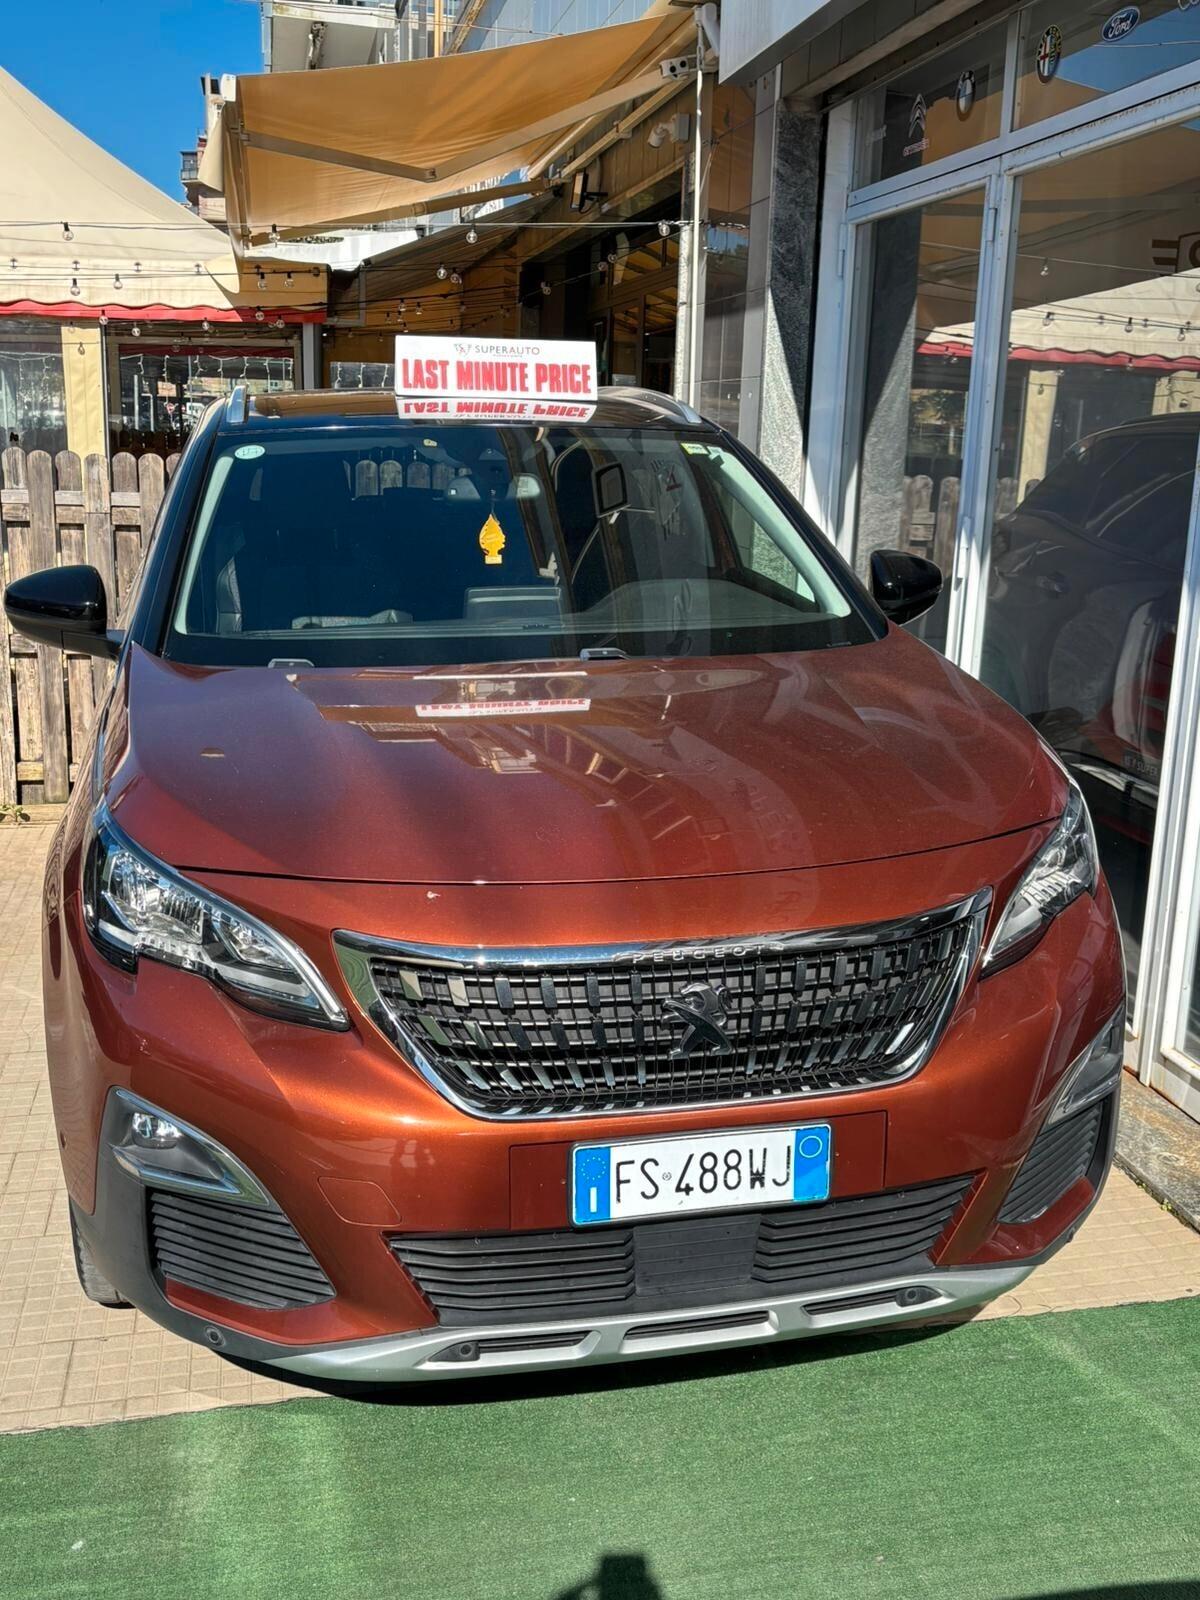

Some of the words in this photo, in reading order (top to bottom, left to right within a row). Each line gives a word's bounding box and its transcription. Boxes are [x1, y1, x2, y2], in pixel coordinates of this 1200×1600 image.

[1107, 13, 1134, 38] Ford
[475, 344, 541, 356] SUPERAUTO
[402, 358, 450, 390] LAST
[456, 360, 529, 393] MINUTE
[535, 362, 592, 394] PRICE
[632, 943, 765, 964] PEUGEOT
[590, 1186, 598, 1213] I
